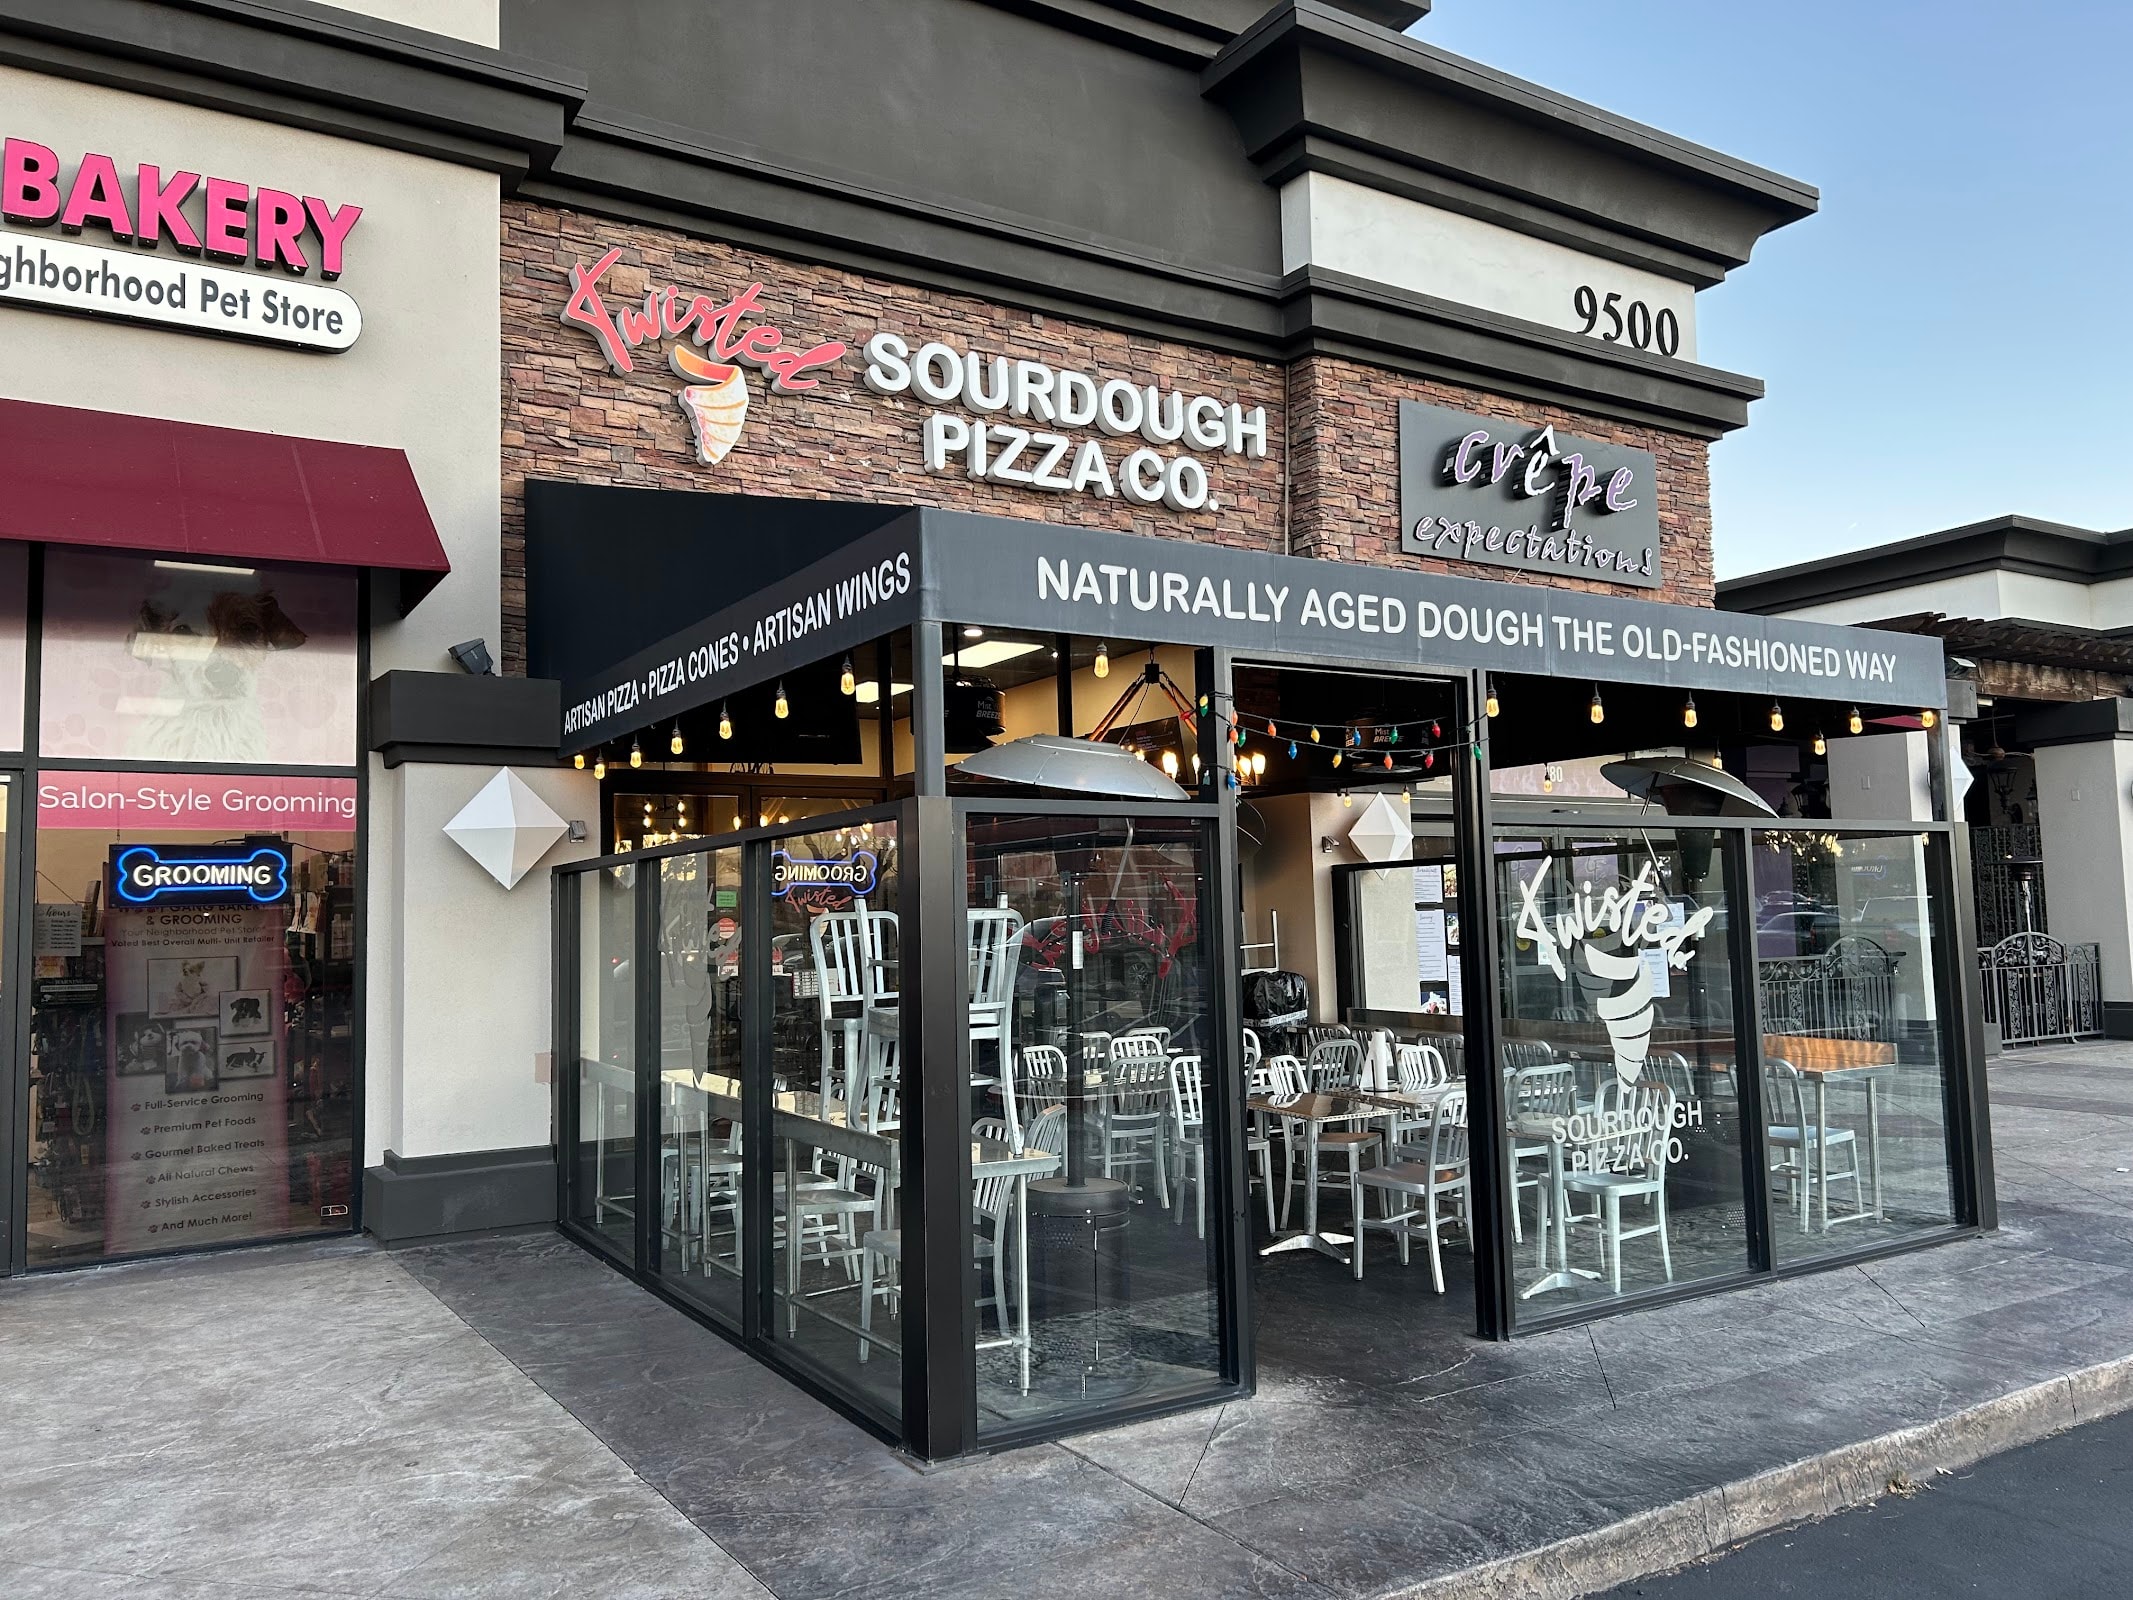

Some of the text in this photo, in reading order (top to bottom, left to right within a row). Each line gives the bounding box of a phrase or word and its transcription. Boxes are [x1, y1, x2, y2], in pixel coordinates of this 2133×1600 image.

[2, 137, 362, 279] BAKERY
[201, 280, 251, 319] Pet
[261, 289, 343, 334] Store
[565, 247, 847, 391] Twisted
[1574, 285, 1679, 357] 9500
[863, 333, 1267, 459] SOURDOUGH
[924, 414, 1220, 512] PIZZA CO.
[1448, 424, 1638, 528] crêpe
[1415, 516, 1653, 576] expectations
[1037, 556, 1897, 683] NATURALLY AGED DOUGH THE OLD-FASHIONED WAY
[564, 551, 911, 736] ARTISAN PIZZA PIZZA CONES ARTISAN WINGS
[39, 785, 356, 818] Salon-Style Grooming
[133, 864, 272, 887] GROOMING
[146, 913, 242, 925] & GROOMING
[111, 939, 139, 947] Voted
[162, 938, 195, 946] Overall
[243, 935, 275, 944] Retailer
[144, 1092, 264, 1110] Full-Service Grooming
[154, 1116, 256, 1134] Premium Pet Foods
[1551, 1100, 1703, 1144] SOURDOUGH
[145, 1139, 265, 1159] Gourmet Baked Treats
[1571, 1143, 1645, 1178] PIZZA
[175, 1167, 215, 1180] Natural
[218, 1165, 254, 1175] Chews
[155, 1188, 257, 1208] Stylish Accessories
[161, 1212, 252, 1231] And Much More!
